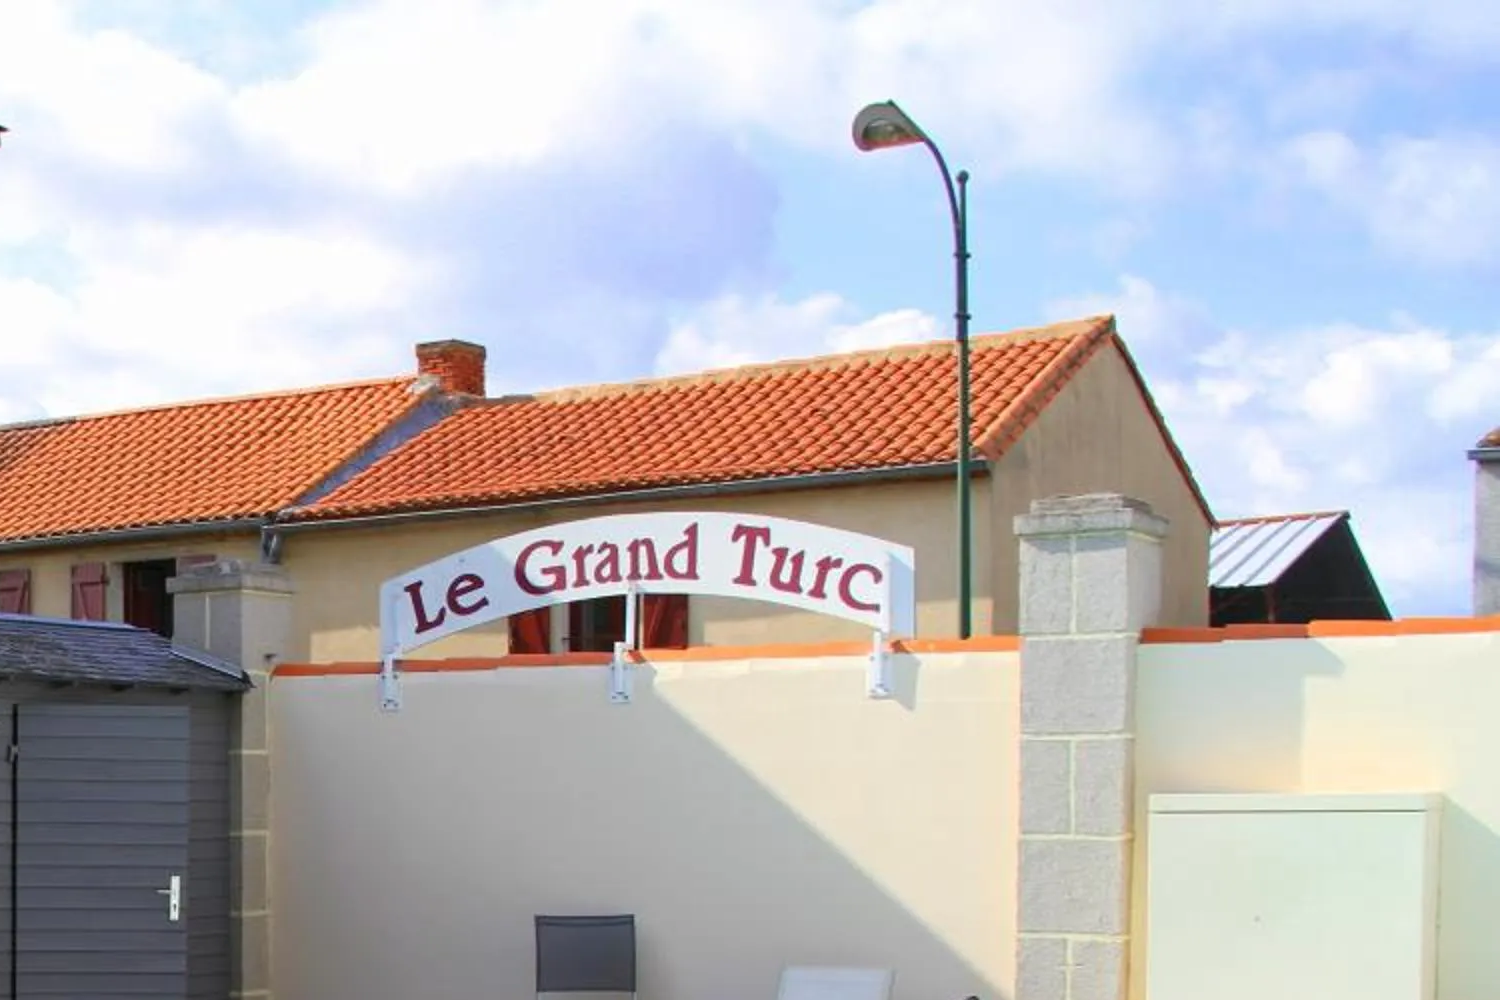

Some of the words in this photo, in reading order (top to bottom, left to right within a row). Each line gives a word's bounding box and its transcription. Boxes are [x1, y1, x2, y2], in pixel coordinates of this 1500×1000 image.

[403, 572, 490, 634] Le
[513, 522, 700, 596] Grand
[731, 523, 884, 612] Turc
